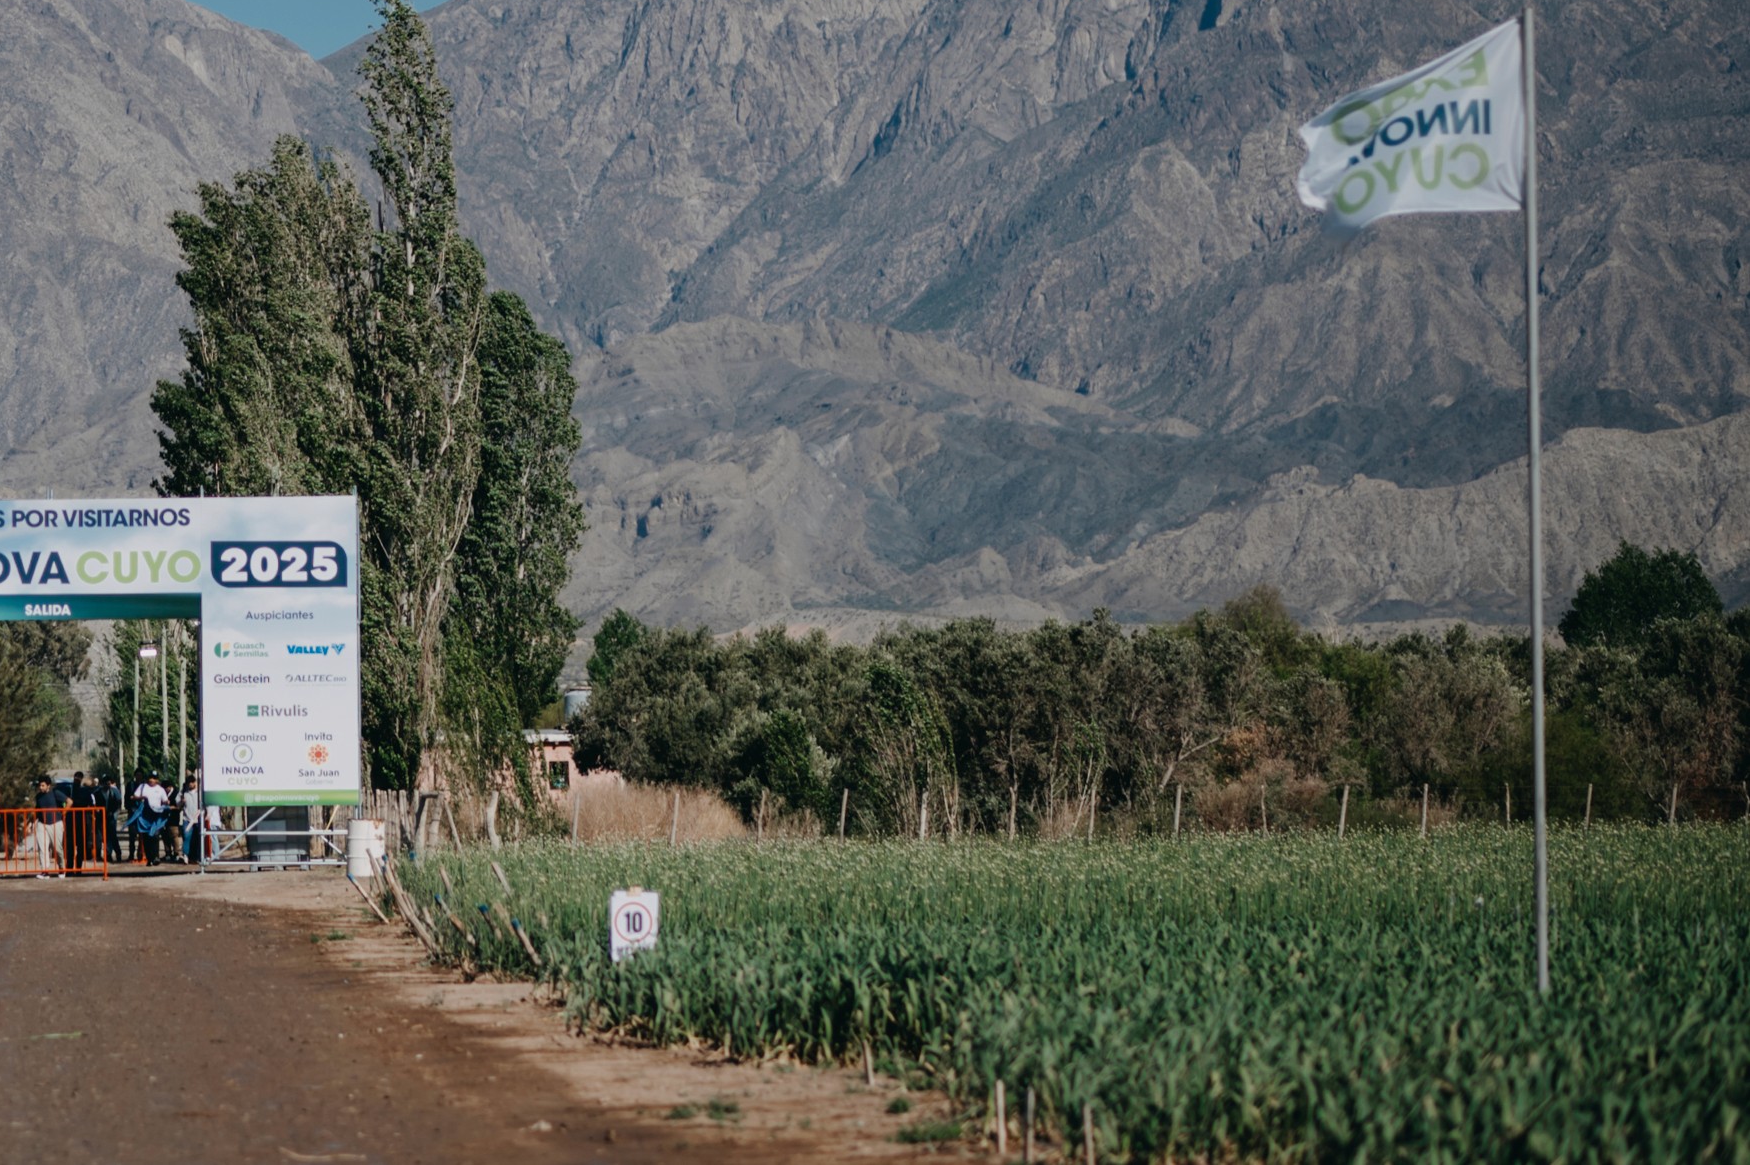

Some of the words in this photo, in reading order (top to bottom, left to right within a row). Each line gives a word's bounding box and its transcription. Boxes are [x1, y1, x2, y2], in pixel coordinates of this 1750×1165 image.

[12, 509, 58, 528] POR
[62, 508, 191, 527] VISITARNOS
[76, 549, 201, 584] CUYO
[220, 546, 338, 582] 2025
[24, 604, 71, 617] SALIDA
[245, 610, 314, 622] Auspiciantes
[233, 642, 265, 650] Guasch
[214, 673, 270, 684] Goldstein
[294, 674, 333, 683] ALLTEC
[260, 704, 308, 717] Rivulis
[219, 732, 267, 744] Organiza
[304, 732, 333, 742] Invita
[221, 766, 264, 775] INNOVA
[298, 768, 315, 777] San
[318, 768, 340, 777] Juan
[227, 777, 258, 786] CUYO
[625, 911, 643, 933] 10
